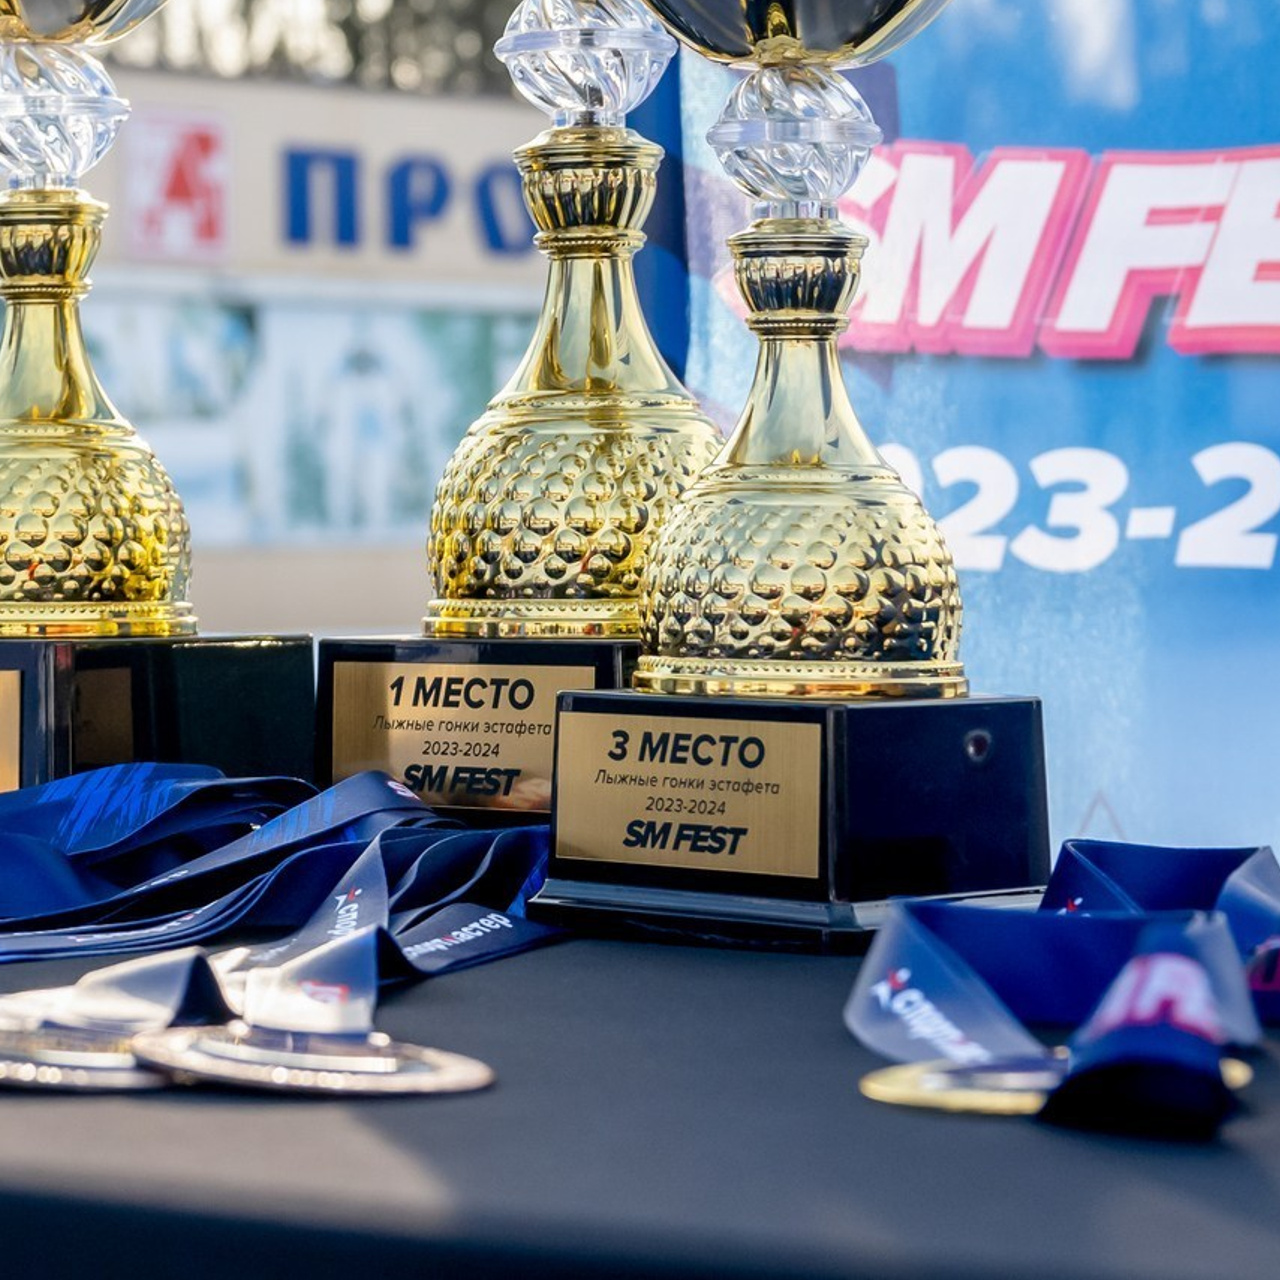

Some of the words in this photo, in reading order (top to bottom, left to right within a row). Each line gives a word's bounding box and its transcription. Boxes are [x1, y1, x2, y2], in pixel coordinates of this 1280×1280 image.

[886, 442, 1280, 573] 23-2
[389, 677, 404, 706] 1
[412, 676, 535, 710] МЕСТО
[372, 715, 434, 732] Лыжные
[438, 719, 480, 734] гонки
[483, 718, 552, 738] эстафета
[422, 741, 500, 758] 2023-2024
[607, 730, 630, 761] 3
[638, 731, 765, 769] МЕСТО
[403, 764, 447, 793] SM
[449, 767, 521, 797] FEST
[594, 769, 658, 788] Лыжные
[662, 776, 705, 792] гонки
[708, 778, 780, 796] эстафета
[645, 796, 727, 816] 2023-2024
[622, 820, 672, 850] SM
[672, 823, 749, 855] FEST
